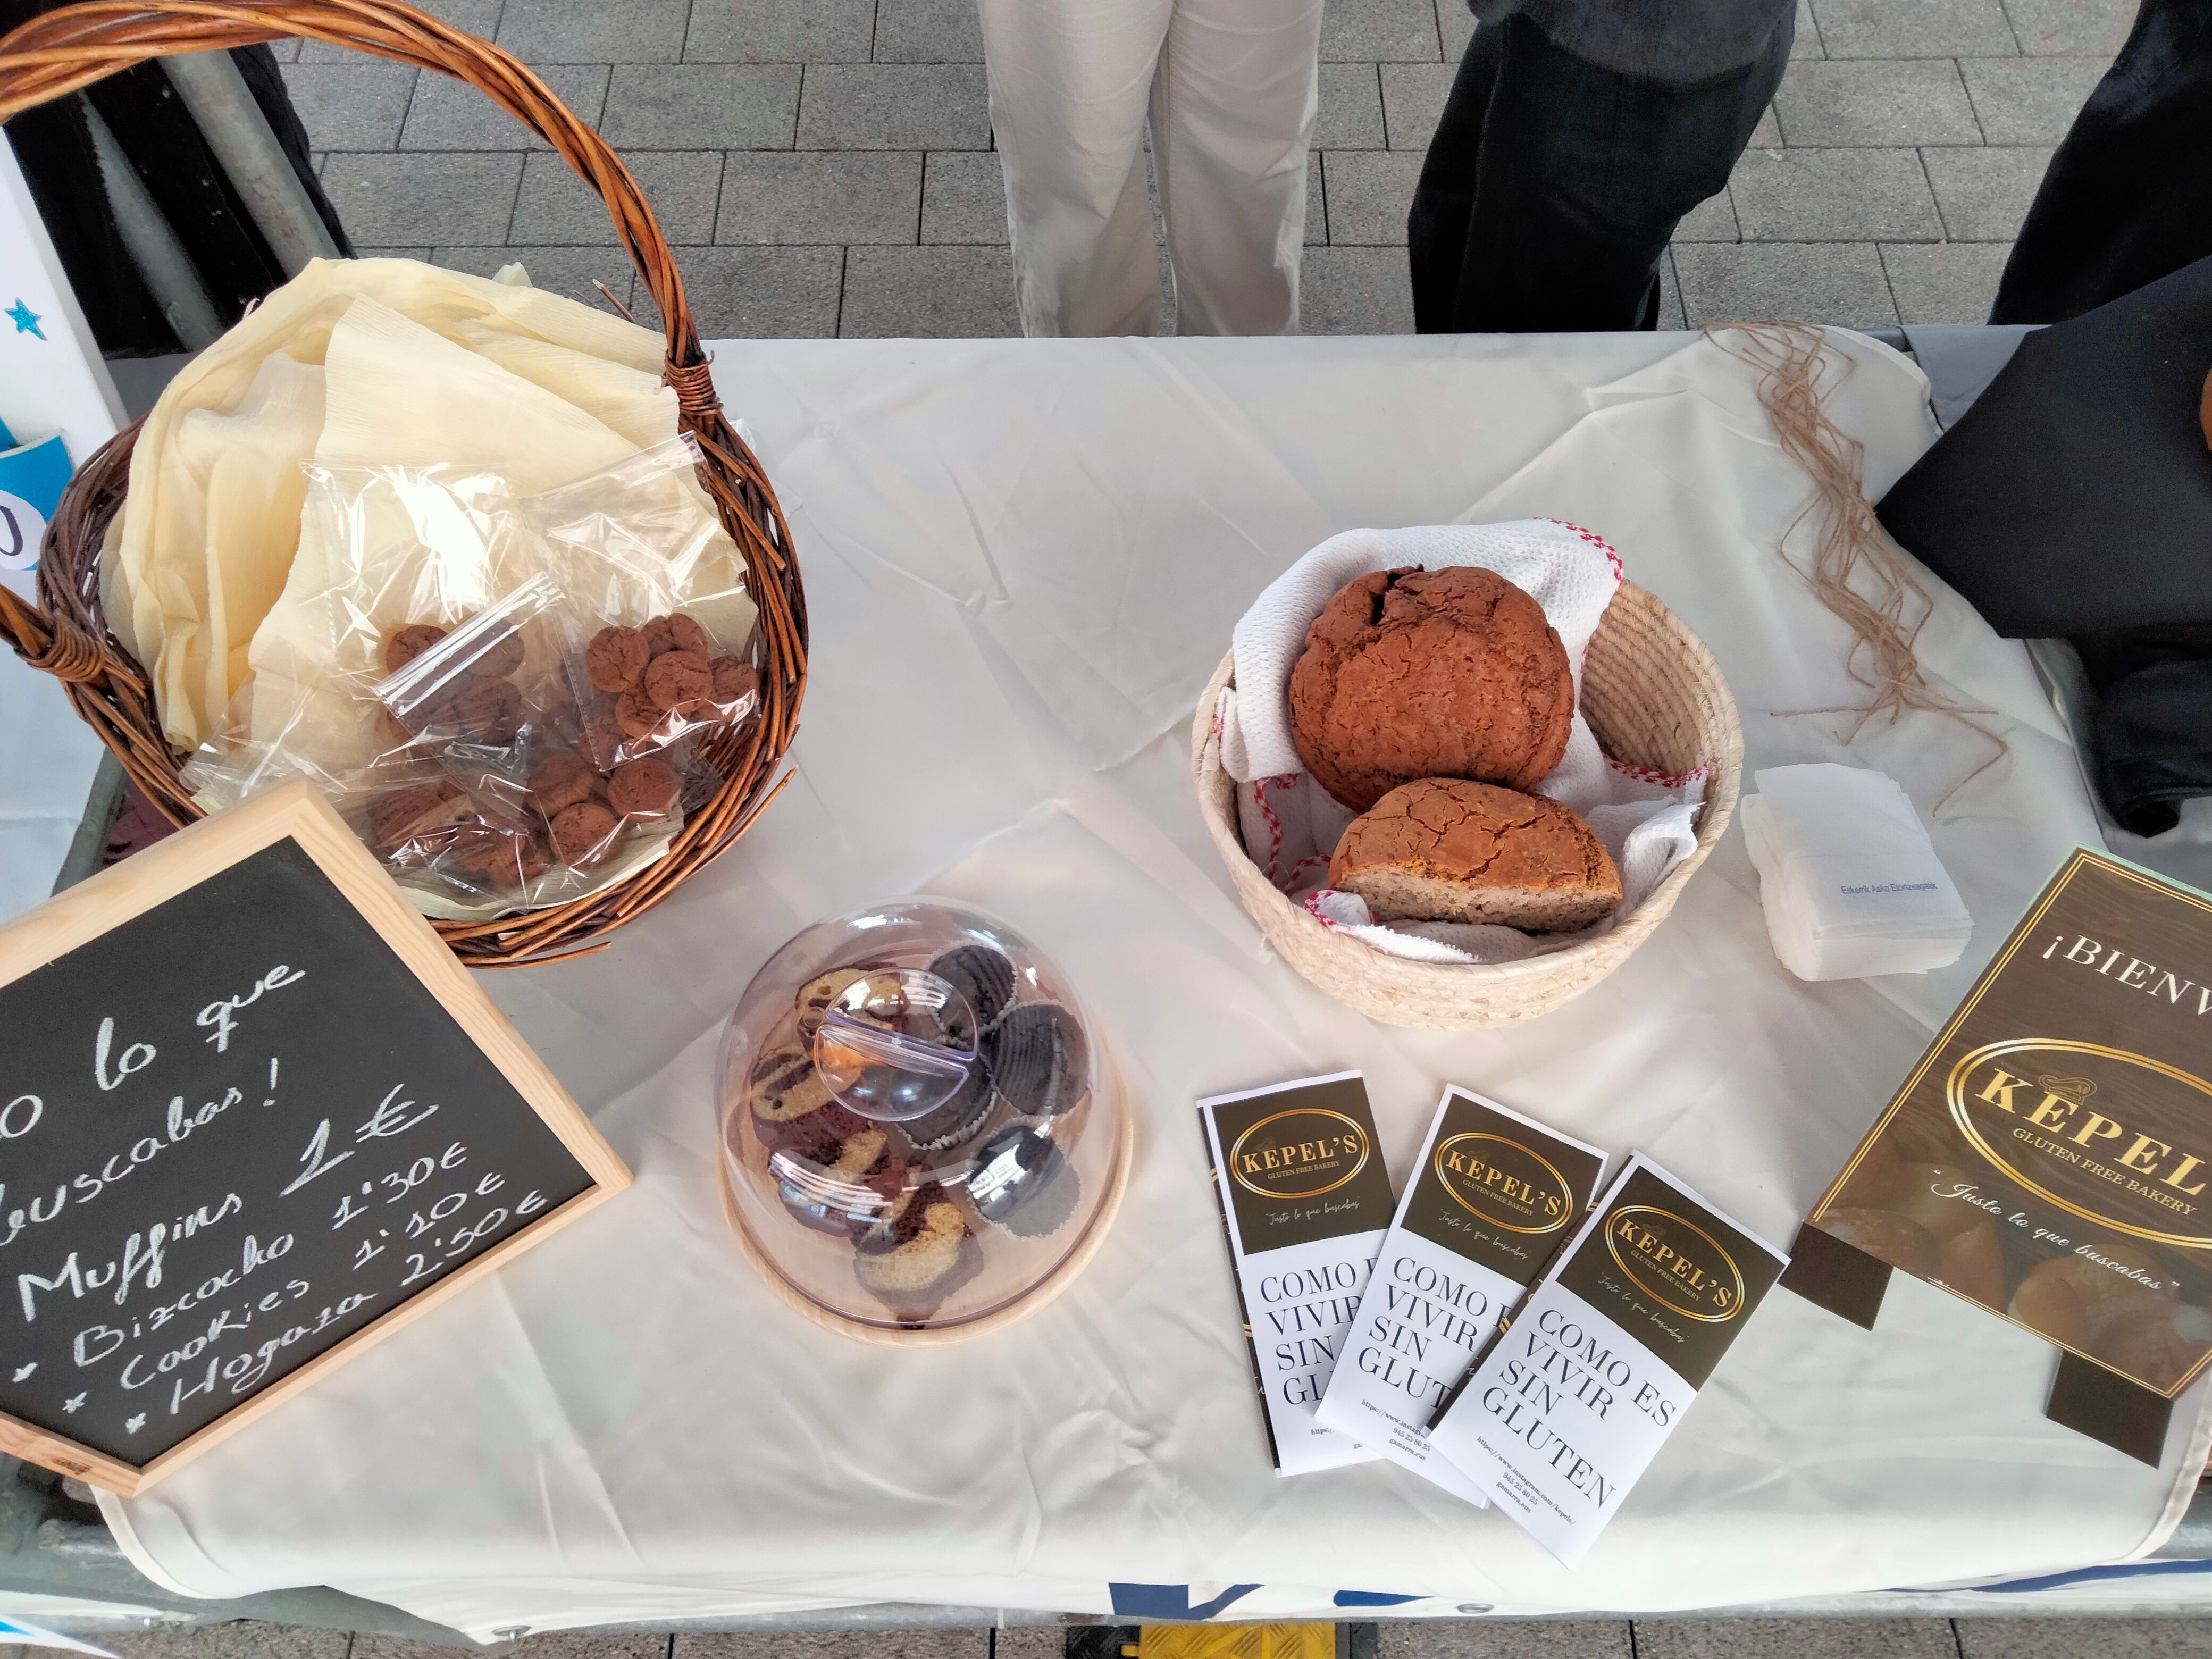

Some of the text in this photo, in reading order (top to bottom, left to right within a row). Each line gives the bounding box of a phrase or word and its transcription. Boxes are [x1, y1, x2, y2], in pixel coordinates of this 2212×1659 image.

[196, 965, 306, 1053] que
[1241, 1135, 1359, 1174] KEPEL'S
[1267, 1160, 1340, 1180] GLUTEN FREE BAKERY
[2012, 1127, 2198, 1217] GLUTEN FREE BAKERY
[1445, 1150, 1562, 1216] KEPEL'S
[1462, 1179, 1535, 1217] GLUTEN FREE BAKERY
[1294, 1209, 1302, 1220] lo
[1305, 1208, 1321, 1221] que
[1463, 1222, 1472, 1232] lo
[1473, 1231, 1490, 1241] que
[2008, 1212, 2029, 1228] lo
[2033, 1227, 2070, 1247] que
[18, 1193, 242, 1322] Muffins
[1616, 1218, 1732, 1308] KEPEL'S
[1630, 1249, 1702, 1302] GLUTEN FREE BAKERY
[1260, 1262, 1356, 1303] COMO
[1393, 1256, 1488, 1317] COMO
[1621, 1292, 1631, 1301] lo
[1631, 1302, 1649, 1314] que
[1368, 1315, 1432, 1362] SIN
[1386, 1283, 1478, 1352] VIVIR
[1275, 1335, 1335, 1371] SIN
[1539, 1310, 1631, 1387] COMO
[1630, 1379, 1677, 1427] ES
[1498, 1360, 1564, 1415] SIN
[1526, 1330, 1614, 1421] VIVIR
[1388, 1438, 1426, 1461] gamarra.eus
[1393, 1427, 1431, 1452] 945 25 80 25
[1482, 1386, 1617, 1509] GLUTEN
[1496, 1481, 1531, 1513] gamarra.eus
[1503, 1472, 1538, 1505] 945 25 80 25
